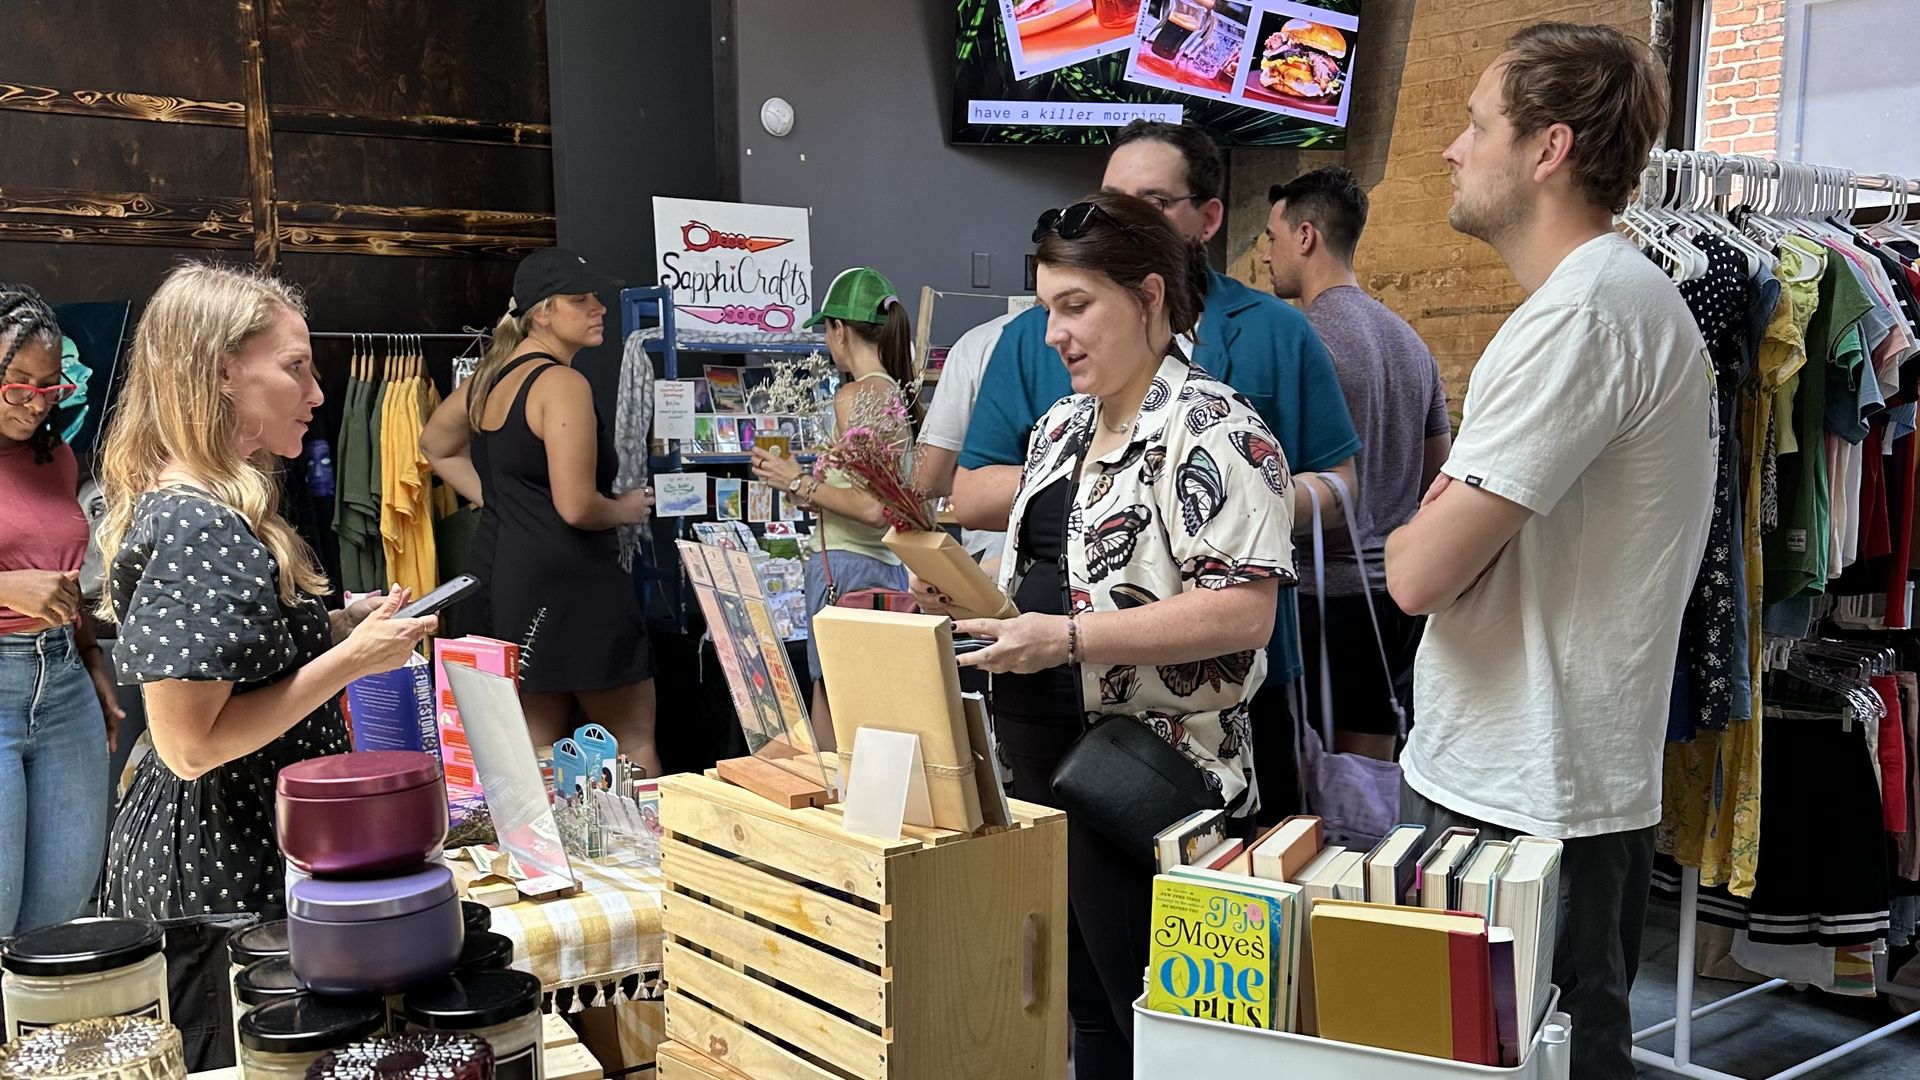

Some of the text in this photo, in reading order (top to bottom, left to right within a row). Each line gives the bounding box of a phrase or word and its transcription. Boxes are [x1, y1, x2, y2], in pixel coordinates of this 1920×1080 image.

[974, 107, 1011, 119] have
[1021, 109, 1029, 119] a
[1039, 108, 1093, 120] killer
[660, 251, 811, 306] SapphiCrafts
[415, 674, 432, 705] FUNNY
[420, 708, 436, 738] STORY
[1204, 895, 1265, 933] Jojo
[1154, 915, 1265, 960] Moyes
[1158, 950, 1265, 1003] One
